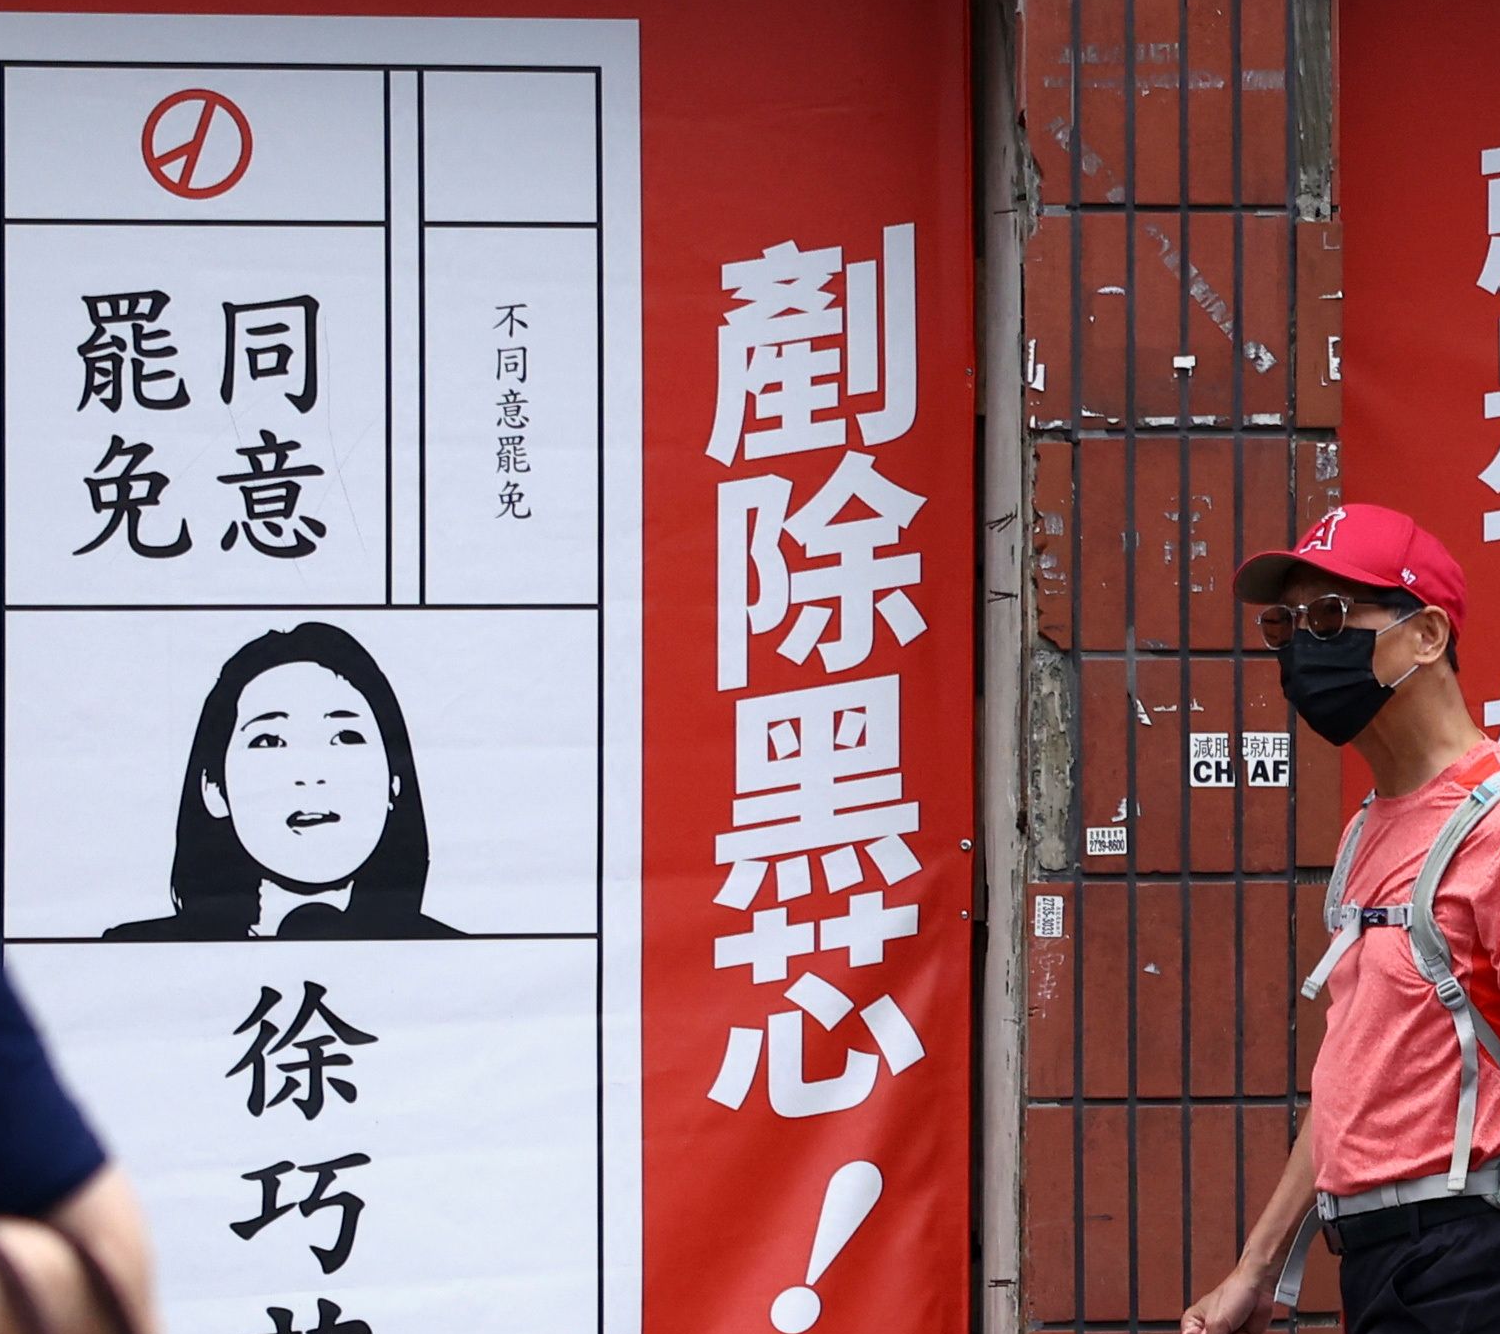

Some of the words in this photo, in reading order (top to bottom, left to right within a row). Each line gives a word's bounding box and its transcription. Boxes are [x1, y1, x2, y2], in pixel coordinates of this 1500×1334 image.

[72, 289, 193, 559] 罷免
[219, 291, 327, 558] 同意
[492, 301, 533, 521] 不同意罷免
[1300, 507, 1347, 555] A
